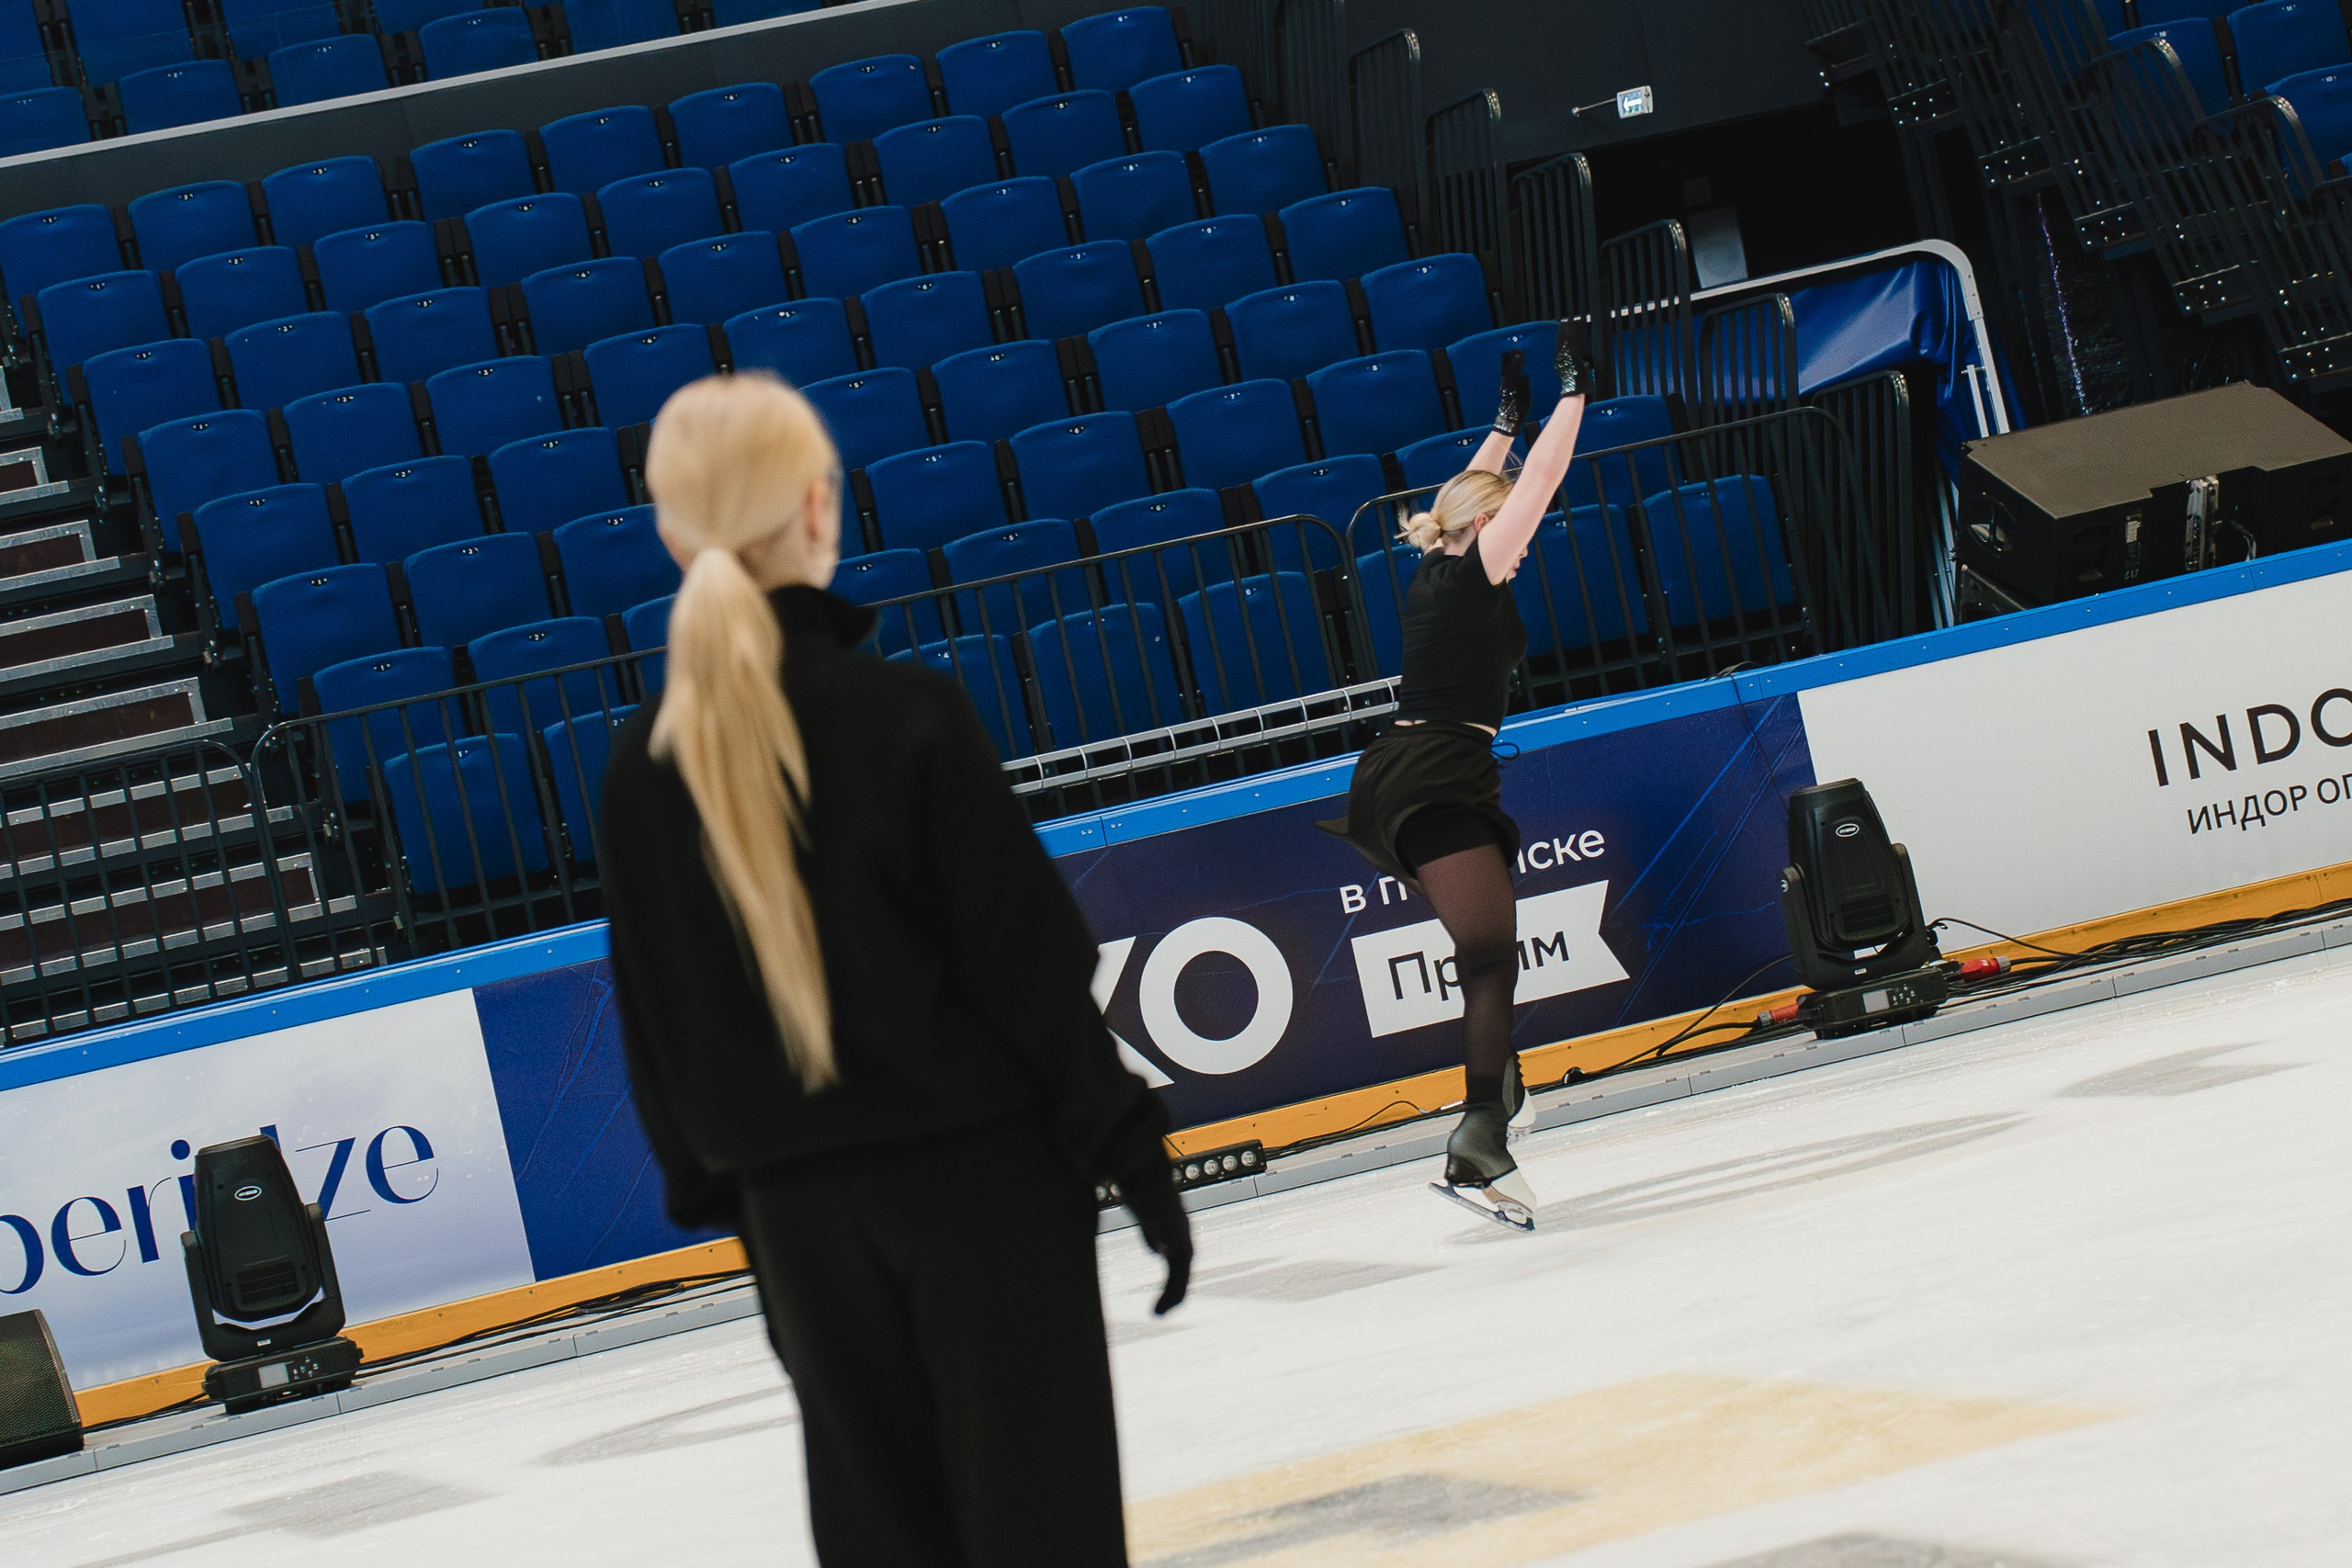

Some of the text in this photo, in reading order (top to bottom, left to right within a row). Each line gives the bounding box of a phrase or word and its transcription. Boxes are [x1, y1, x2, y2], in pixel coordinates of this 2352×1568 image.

[2187, 784, 2308, 835] ИНДОР
[1340, 884, 1367, 914] в
[1387, 931, 1570, 1002] Прм
